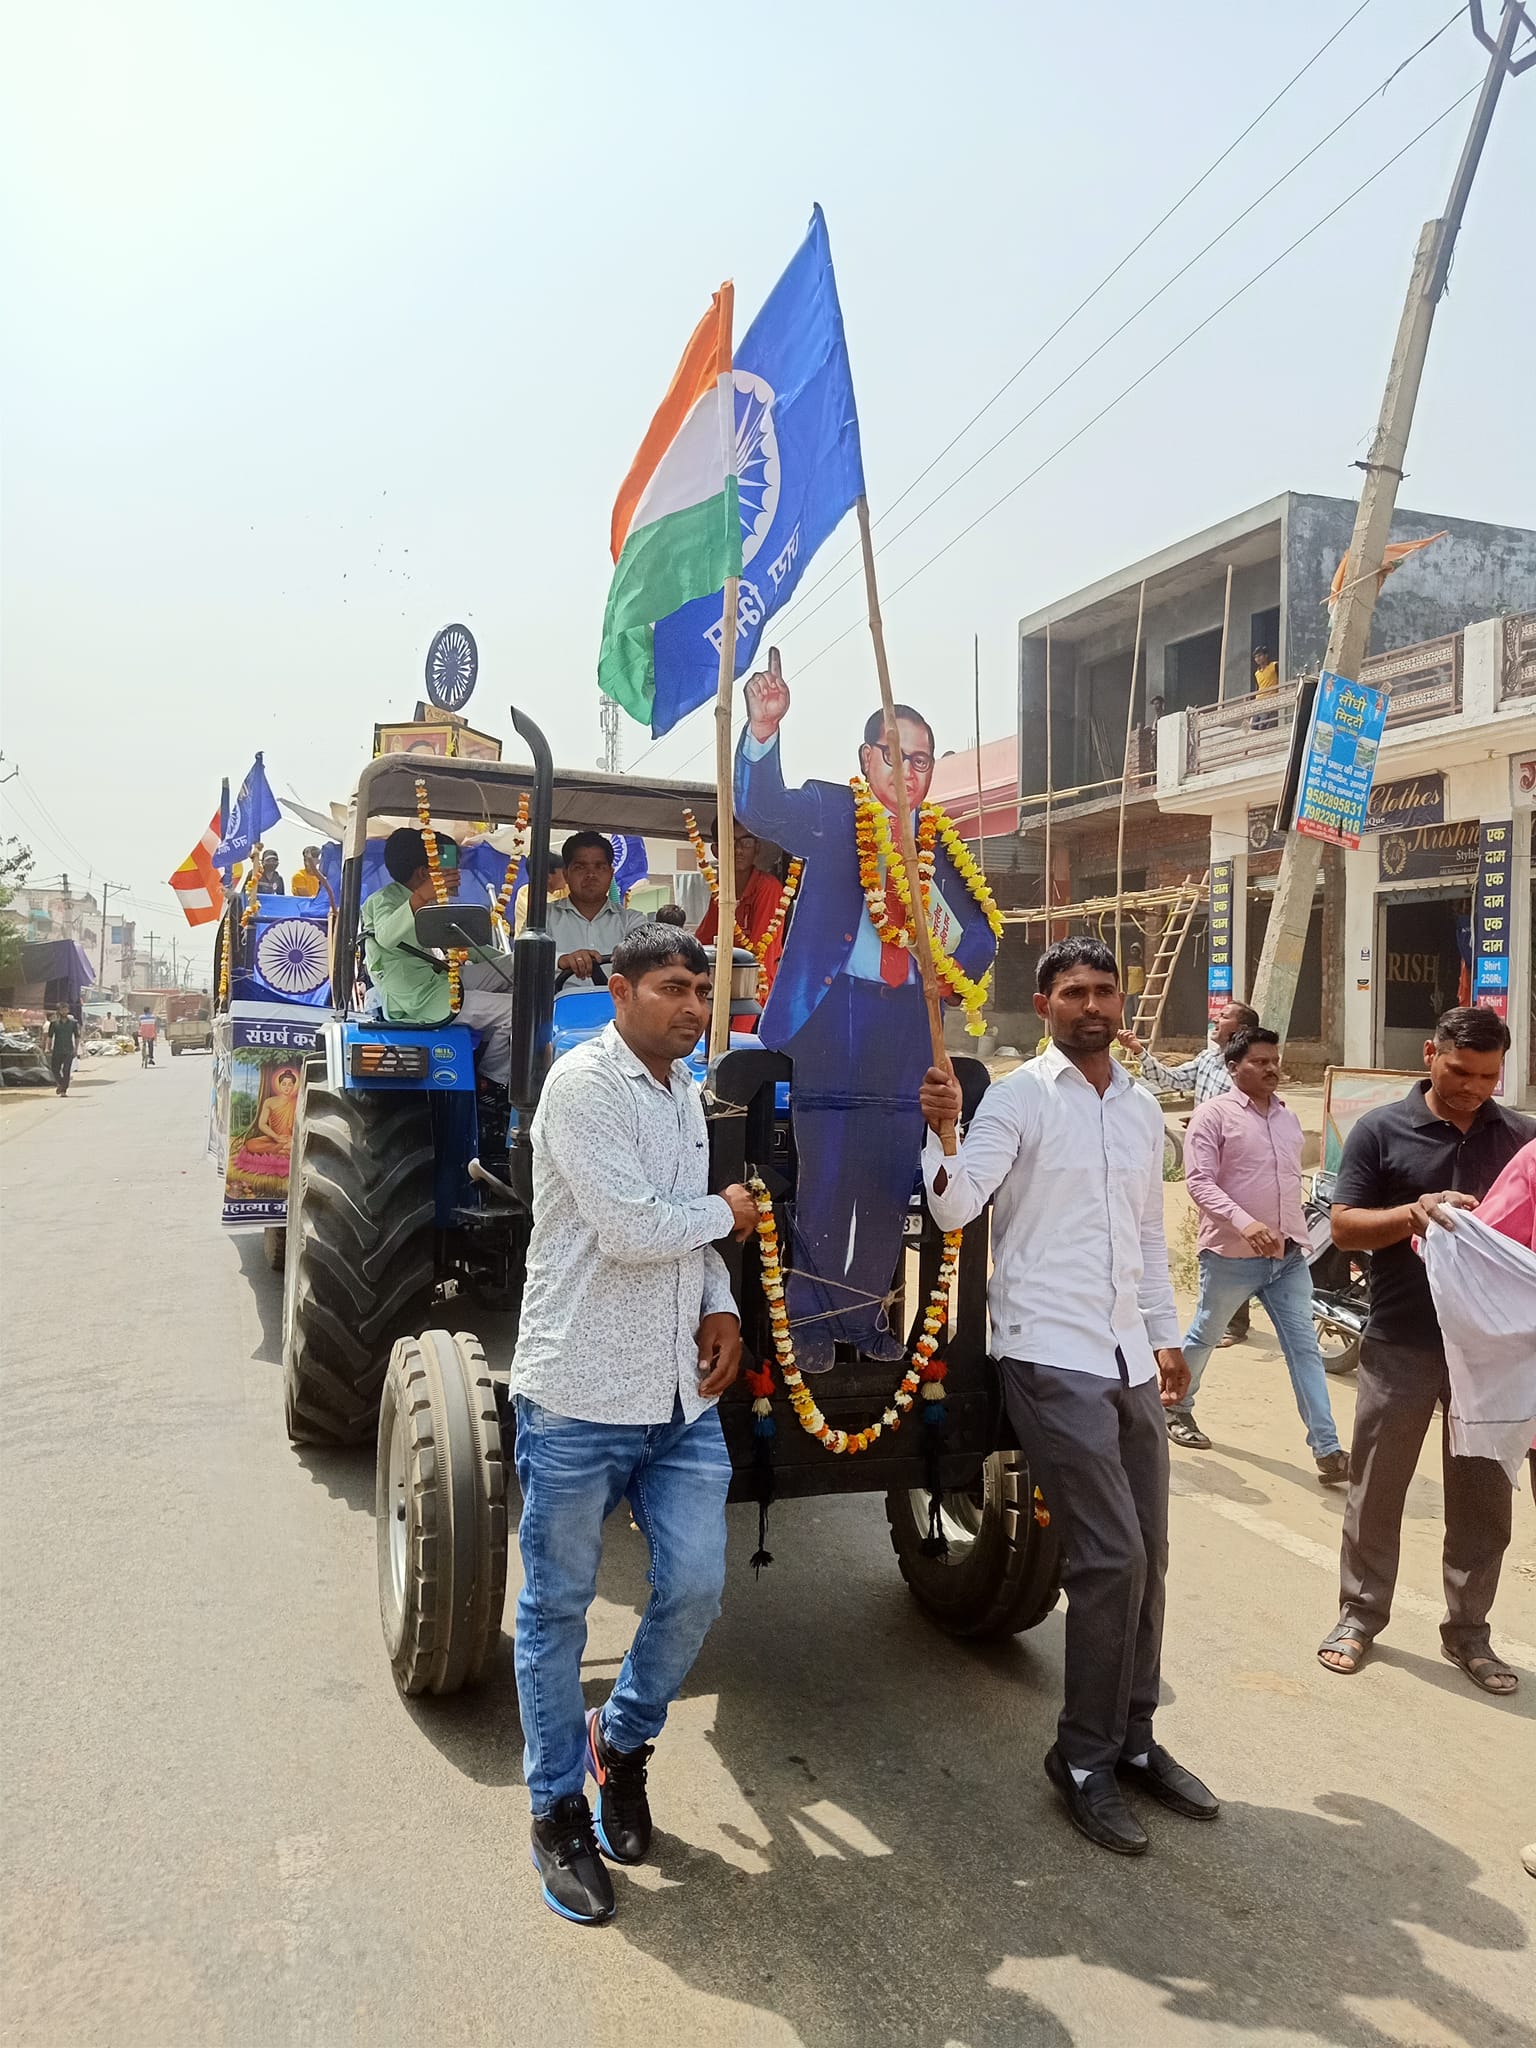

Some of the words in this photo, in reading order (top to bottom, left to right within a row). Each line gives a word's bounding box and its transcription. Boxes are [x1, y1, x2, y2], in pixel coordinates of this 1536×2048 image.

[1306, 787, 1363, 817] 9582895831
[1366, 782, 1440, 815] Clothes
[1486, 827, 1506, 843] एक
[1485, 850, 1506, 864] दाम
[1213, 866, 1228, 878] एक
[1485, 872, 1505, 887] एक
[1212, 883, 1229, 895] दाम
[1212, 901, 1228, 913] एक
[1483, 894, 1505, 908] दाम
[1212, 917, 1229, 929] दाम
[1483, 917, 1503, 931] एक
[1212, 935, 1228, 947] एक
[1482, 939, 1504, 953] दाम
[1211, 952, 1229, 964] दाम
[1483, 960, 1501, 971] Shirt
[245, 1024, 289, 1045] संघर्ष
